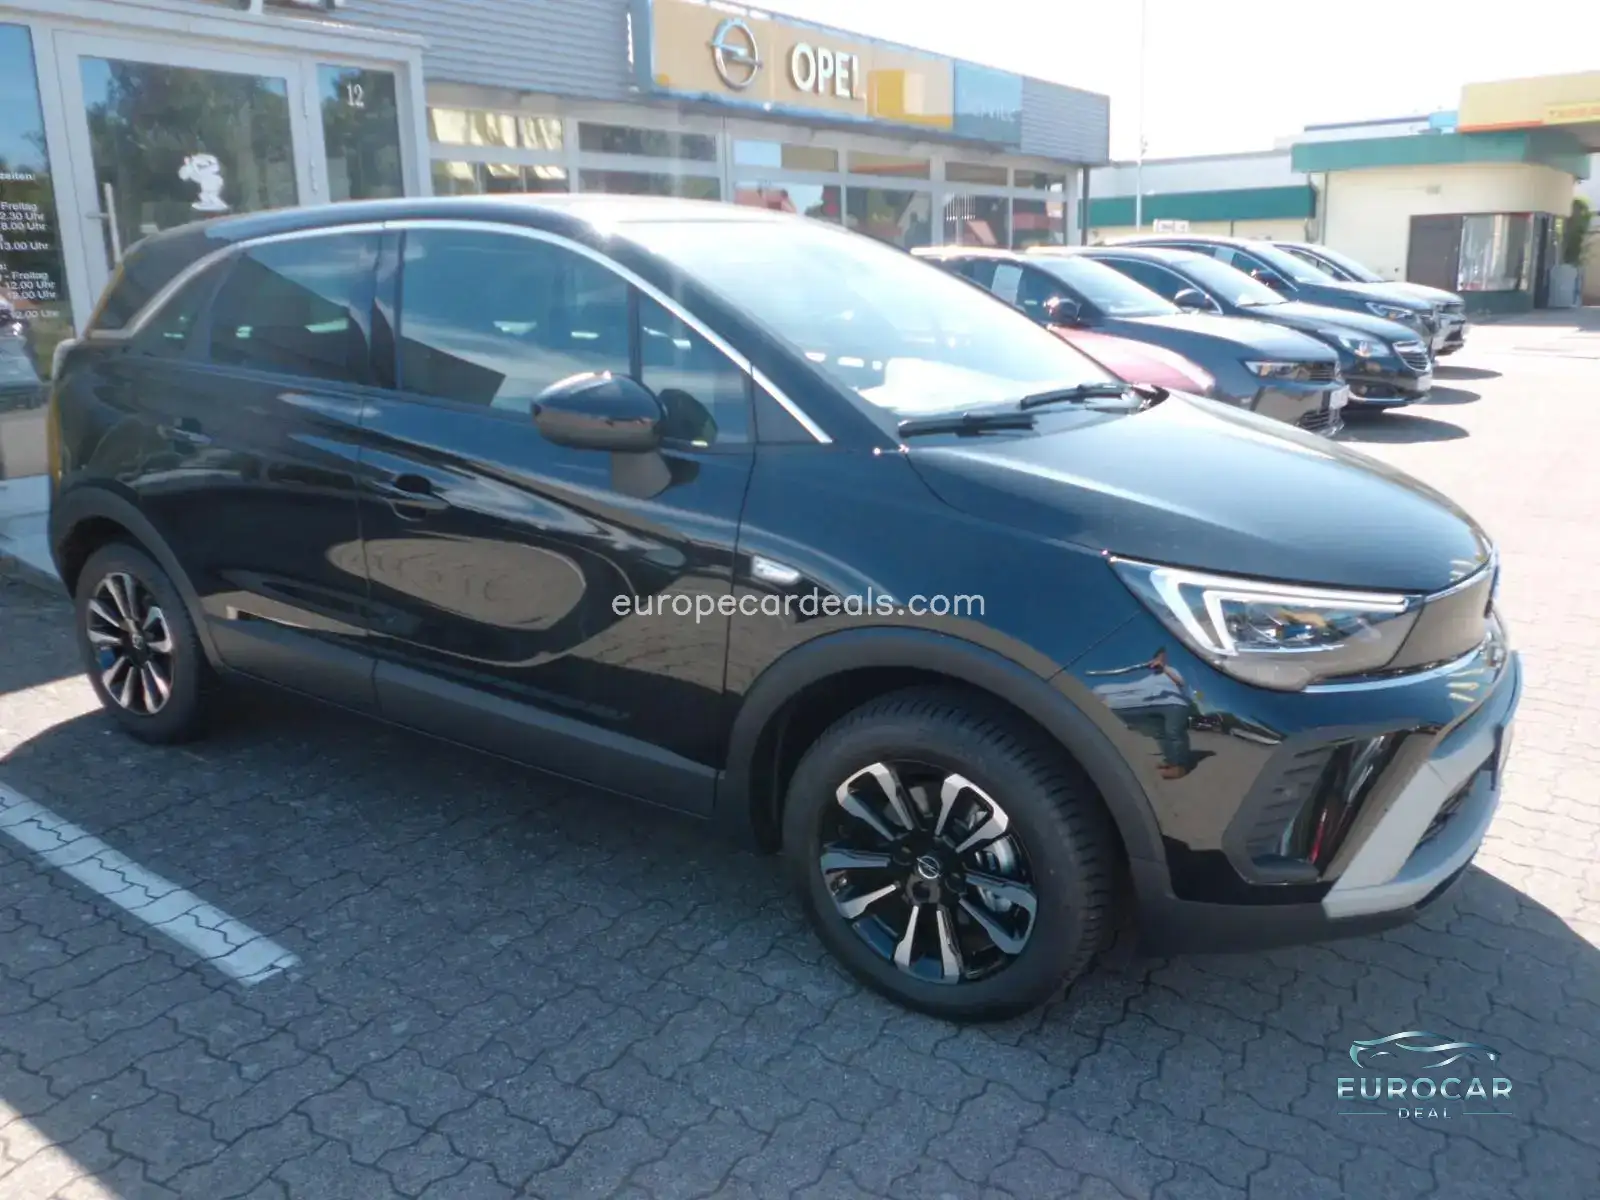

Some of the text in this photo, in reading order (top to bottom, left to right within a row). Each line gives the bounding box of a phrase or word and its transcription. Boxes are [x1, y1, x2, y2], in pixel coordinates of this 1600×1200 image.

[791, 42, 866, 100] OPEL
[346, 81, 364, 108] 12
[1, 201, 37, 212] Freitag
[26, 212, 44, 221] Uhr
[26, 222, 47, 231] Uhr
[30, 241, 48, 250] Uhr
[36, 281, 56, 289] Uhr
